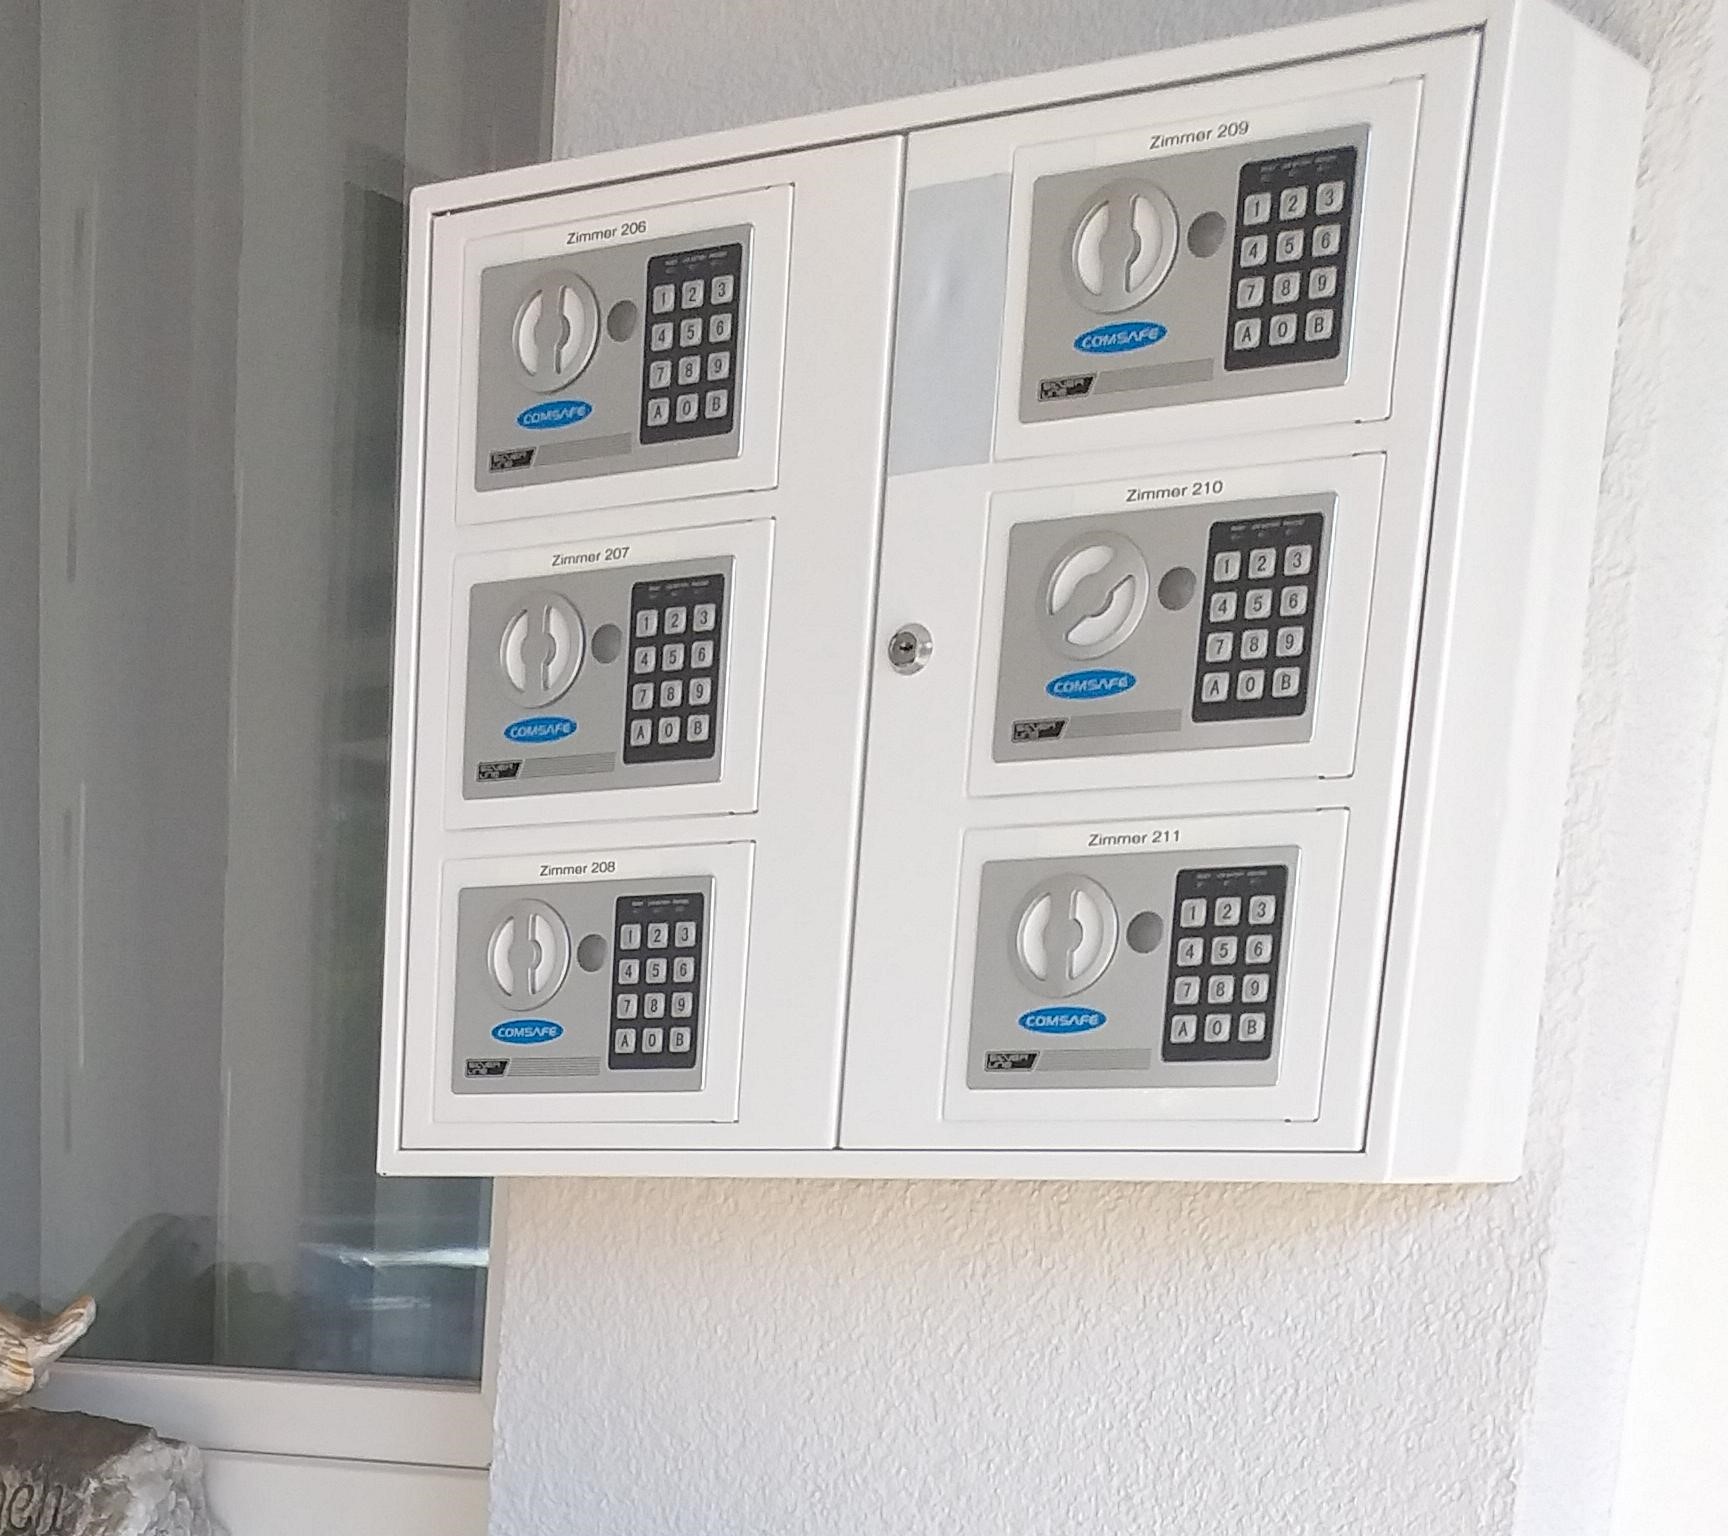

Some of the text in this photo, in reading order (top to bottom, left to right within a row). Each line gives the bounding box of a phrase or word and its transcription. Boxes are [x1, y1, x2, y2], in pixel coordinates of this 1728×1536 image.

[1148, 120, 1251, 150] Zimmer 209
[1254, 188, 1334, 218] 1 2 3
[566, 220, 648, 245] Zimmer 206
[1248, 231, 1331, 259] 4 5 6
[660, 281, 726, 307] 1 2 3
[1246, 274, 1327, 301] 7 8 9
[657, 320, 724, 343] 4 5 6
[1080, 326, 1160, 349] COMSAFE
[1241, 316, 1324, 343] A 0 B
[655, 358, 723, 382] 7 8 9
[522, 405, 587, 425] COMSAFE
[653, 396, 721, 419] A 0 B
[1125, 480, 1224, 502] Zimmer 210
[551, 546, 631, 567] Zimmer 207
[1223, 551, 1302, 574] 1 2 3
[1217, 592, 1298, 614] 4 5 6
[643, 609, 708, 631] 1 2 3
[1215, 633, 1295, 655] 7 8 9
[639, 646, 706, 666] 4 5 6
[639, 683, 704, 703] 7 8 9
[1052, 675, 1129, 693] COMSAFE
[1209, 673, 1291, 696] A 0 B
[509, 721, 572, 738] COMSAFE
[636, 720, 703, 740] A 0 B
[1087, 829, 1182, 847] Zimmer 211
[539, 861, 617, 877] Zimmer 208
[1190, 901, 1267, 921] 1 2 3
[627, 927, 689, 944] 1 2 3
[1184, 941, 1263, 959] 4 5 6
[623, 962, 687, 978] 4 5 6
[1182, 979, 1260, 998] 7 8 9
[623, 997, 686, 1013] 7 8 9
[1025, 1012, 1100, 1027] COMSAFE
[1177, 1019, 1257, 1037] A 0 B
[496, 1026, 558, 1038] COMSAFE
[620, 1032, 684, 1048] A 0 B
